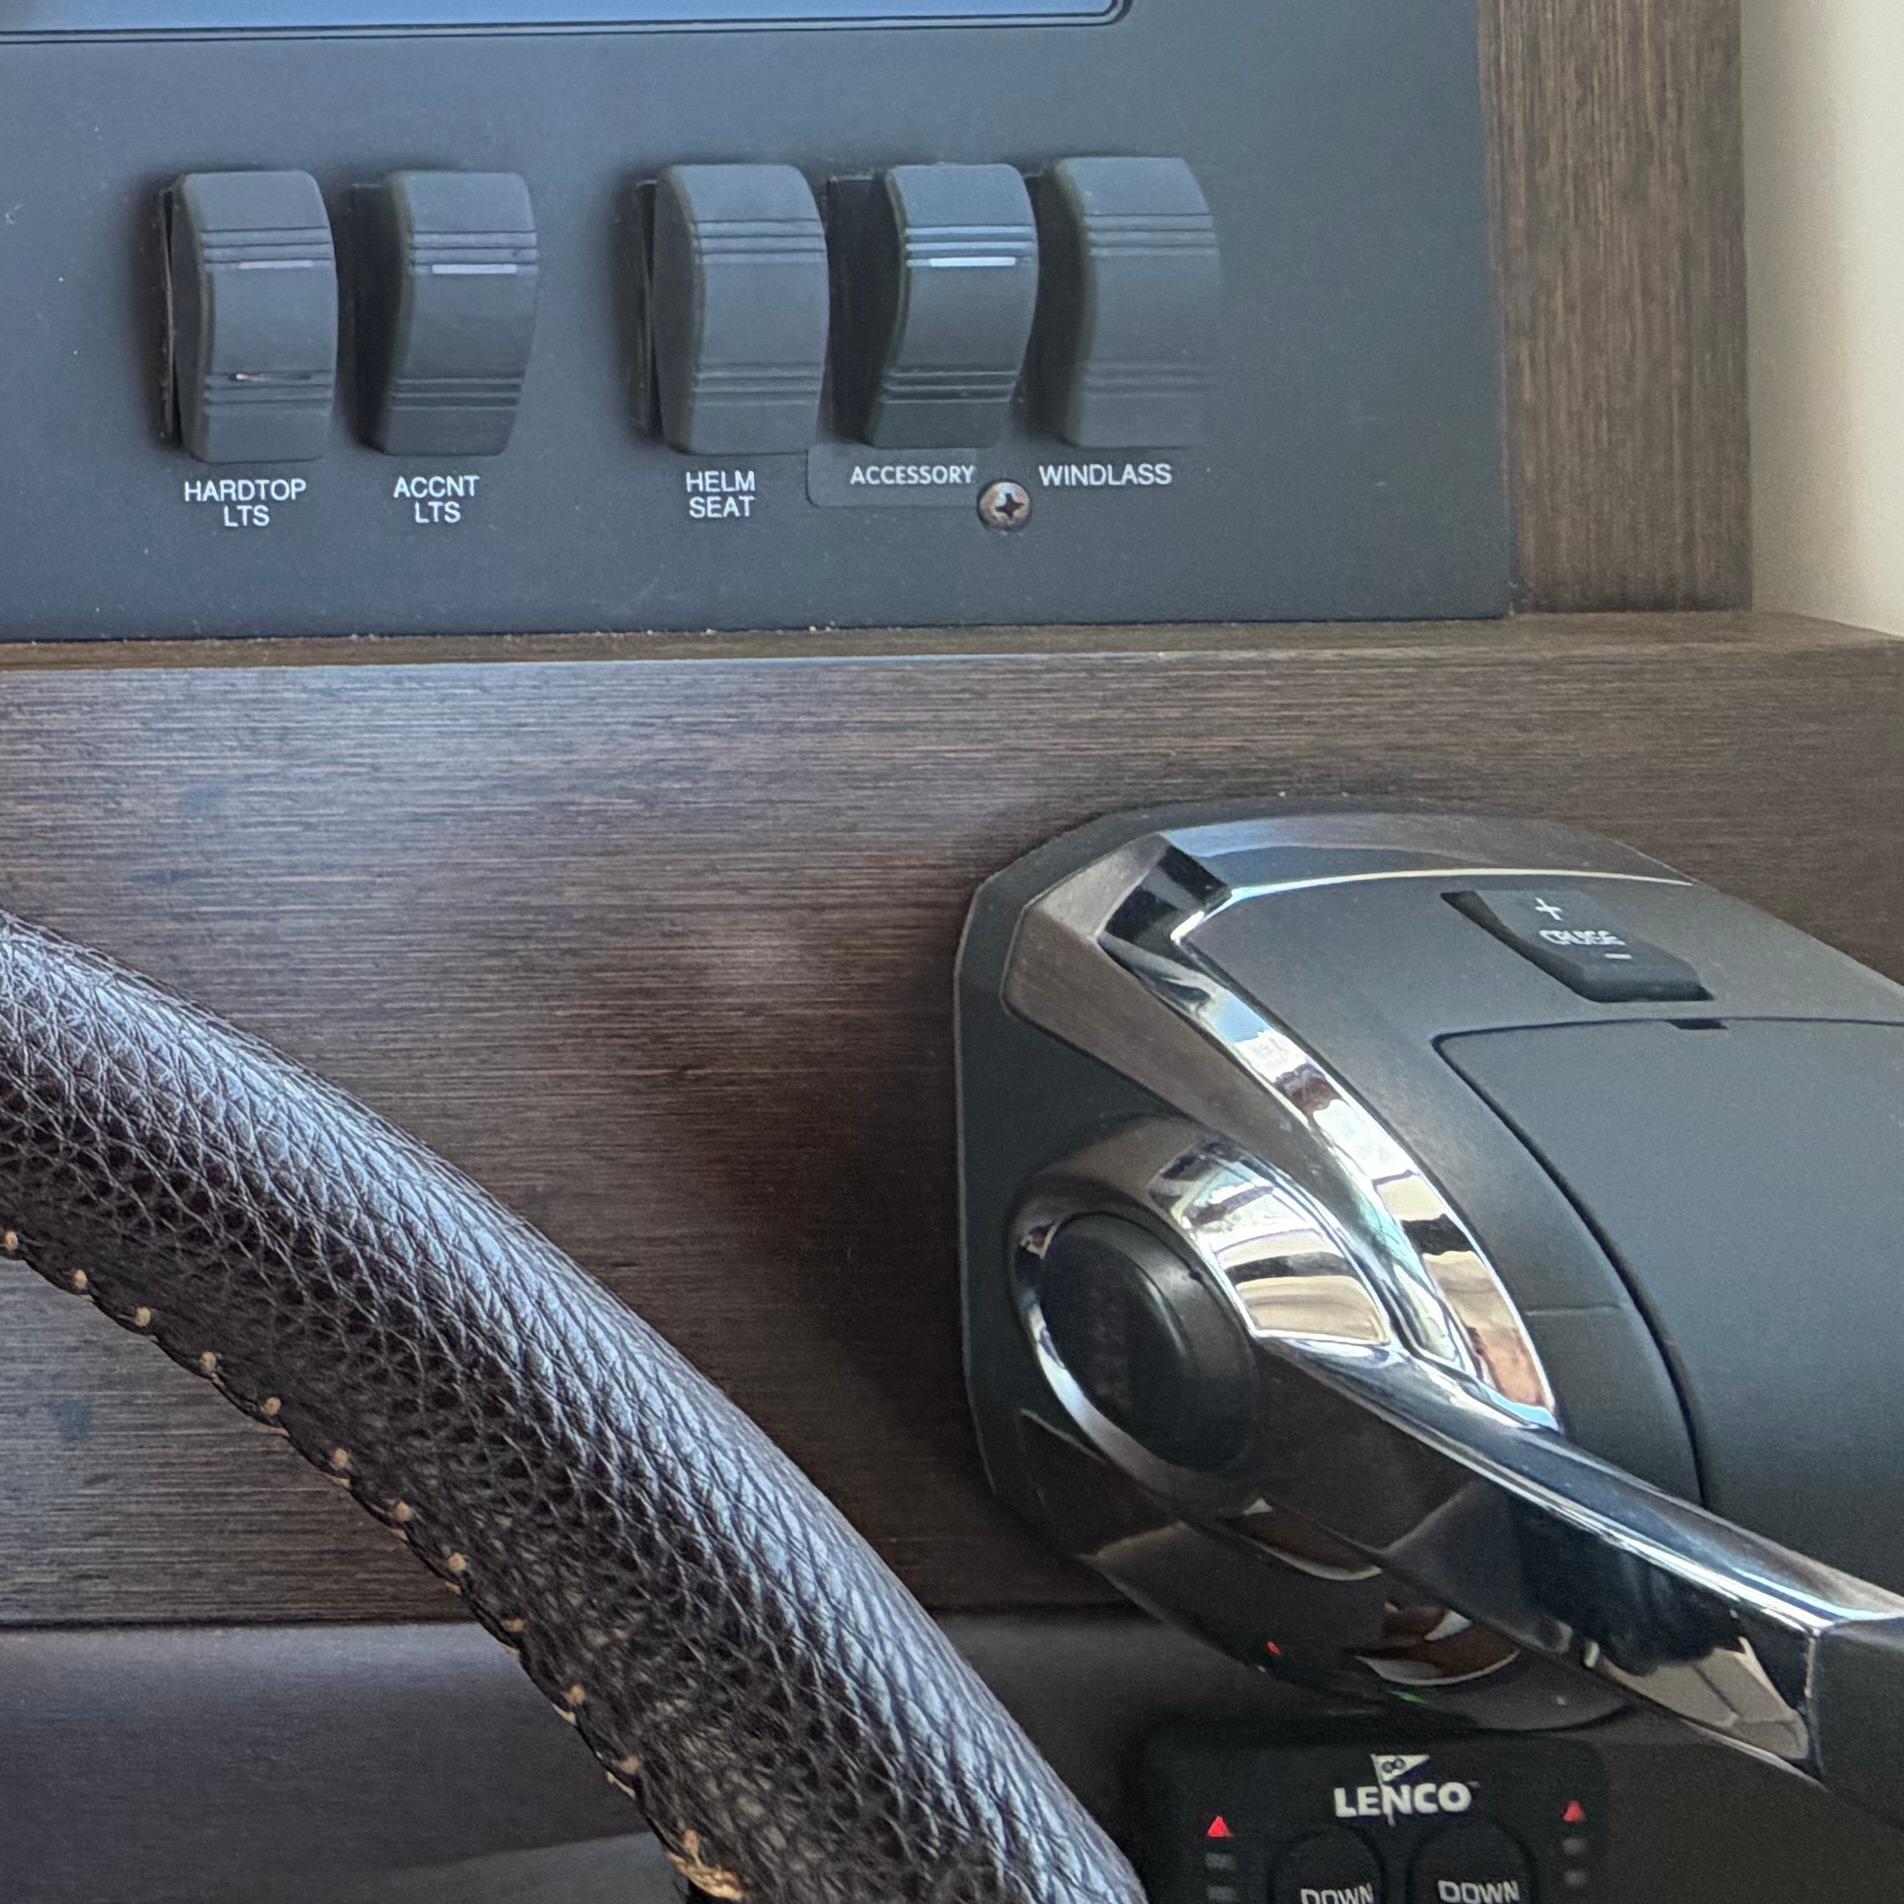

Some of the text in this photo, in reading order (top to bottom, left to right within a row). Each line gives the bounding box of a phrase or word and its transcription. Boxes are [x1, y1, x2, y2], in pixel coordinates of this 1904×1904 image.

[393, 475, 480, 498] ACCNT
[685, 470, 756, 493] HELM
[850, 464, 977, 486] ACCESSORY
[1039, 463, 1173, 487] WINDLASS
[184, 478, 307, 502] HARDTOP
[223, 505, 271, 528] LTS
[414, 501, 461, 524] LTS
[688, 495, 756, 518] SEAT
[1334, 1780, 1473, 1818] LENCO
[1438, 1879, 1522, 1904] DOWN
